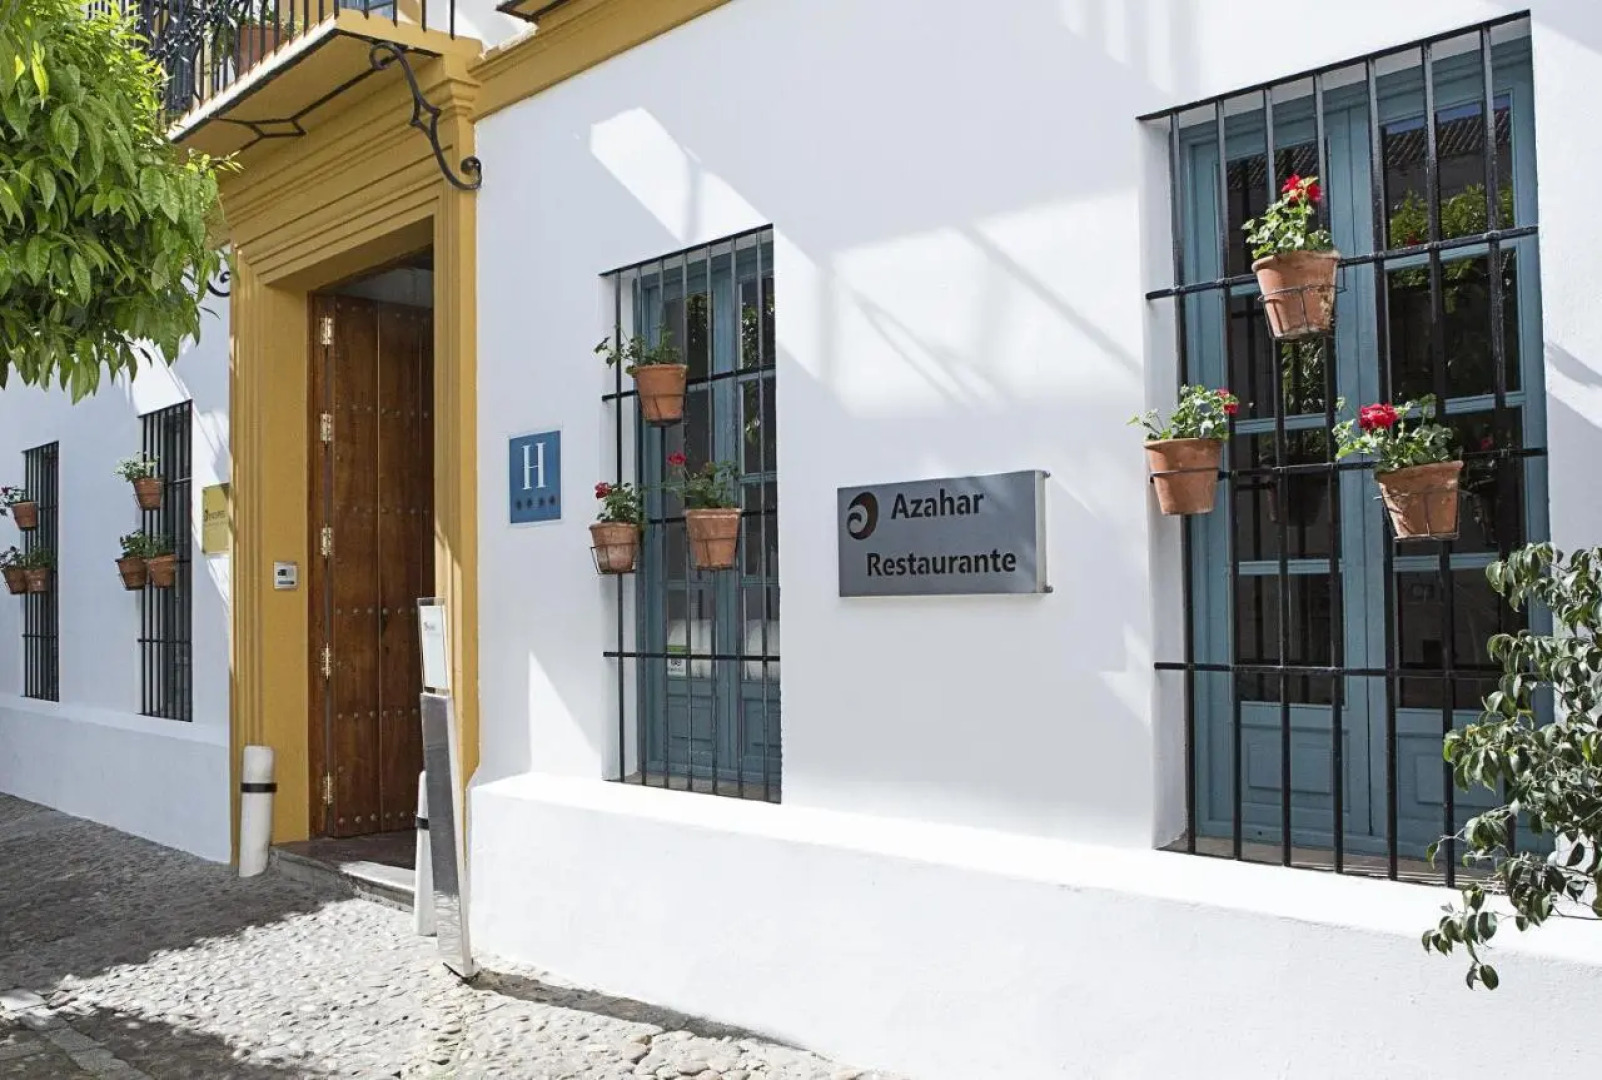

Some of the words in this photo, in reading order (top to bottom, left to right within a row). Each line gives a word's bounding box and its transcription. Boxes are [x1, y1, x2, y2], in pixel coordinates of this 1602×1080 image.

[522, 442, 546, 490] H
[890, 488, 984, 519] Azahar
[866, 549, 1017, 576] Restaurante
